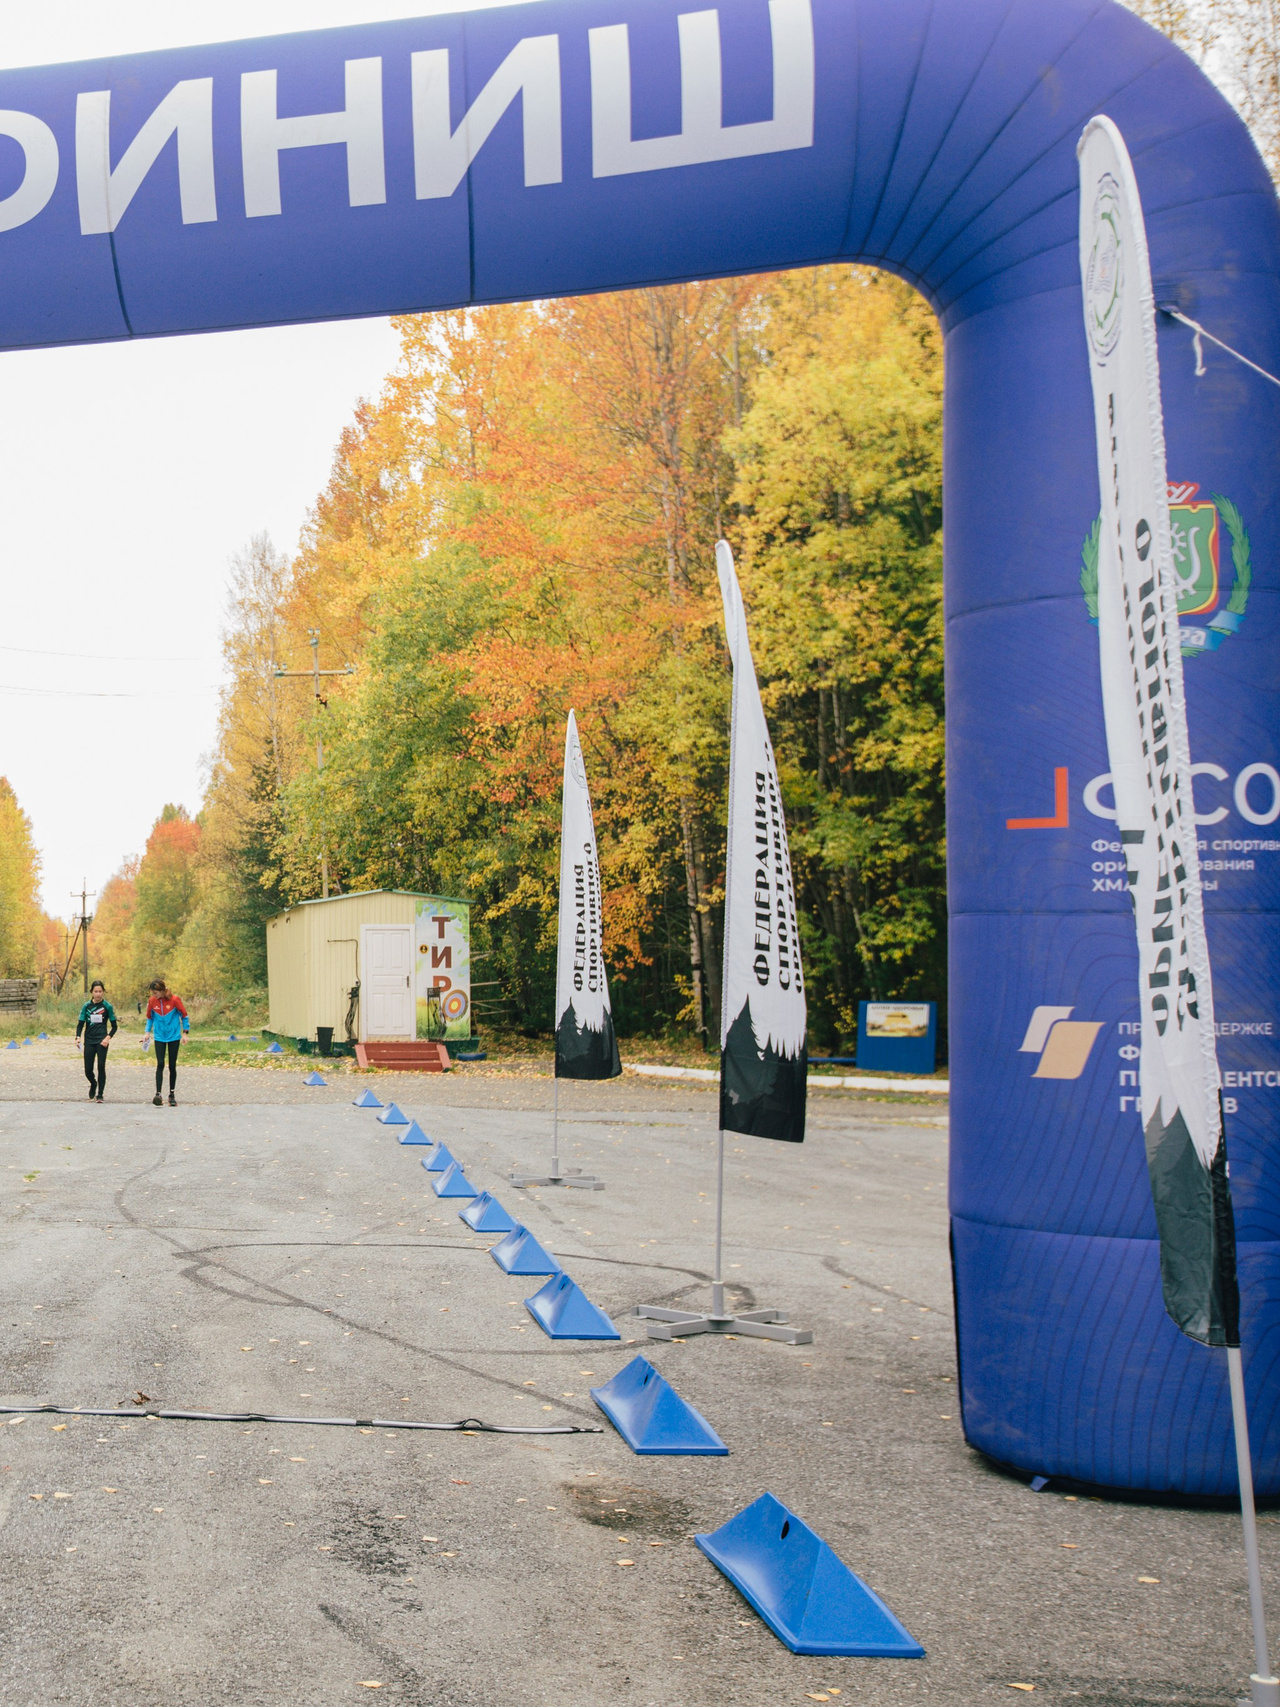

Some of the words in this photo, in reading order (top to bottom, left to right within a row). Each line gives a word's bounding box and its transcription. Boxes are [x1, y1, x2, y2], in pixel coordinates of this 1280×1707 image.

[573, 864, 587, 992] ФЕДЕРАЦИЯ
[583, 842, 598, 993] СПОРТИВНОГО
[752, 771, 772, 987] ФЕДЕРАЦИЯ
